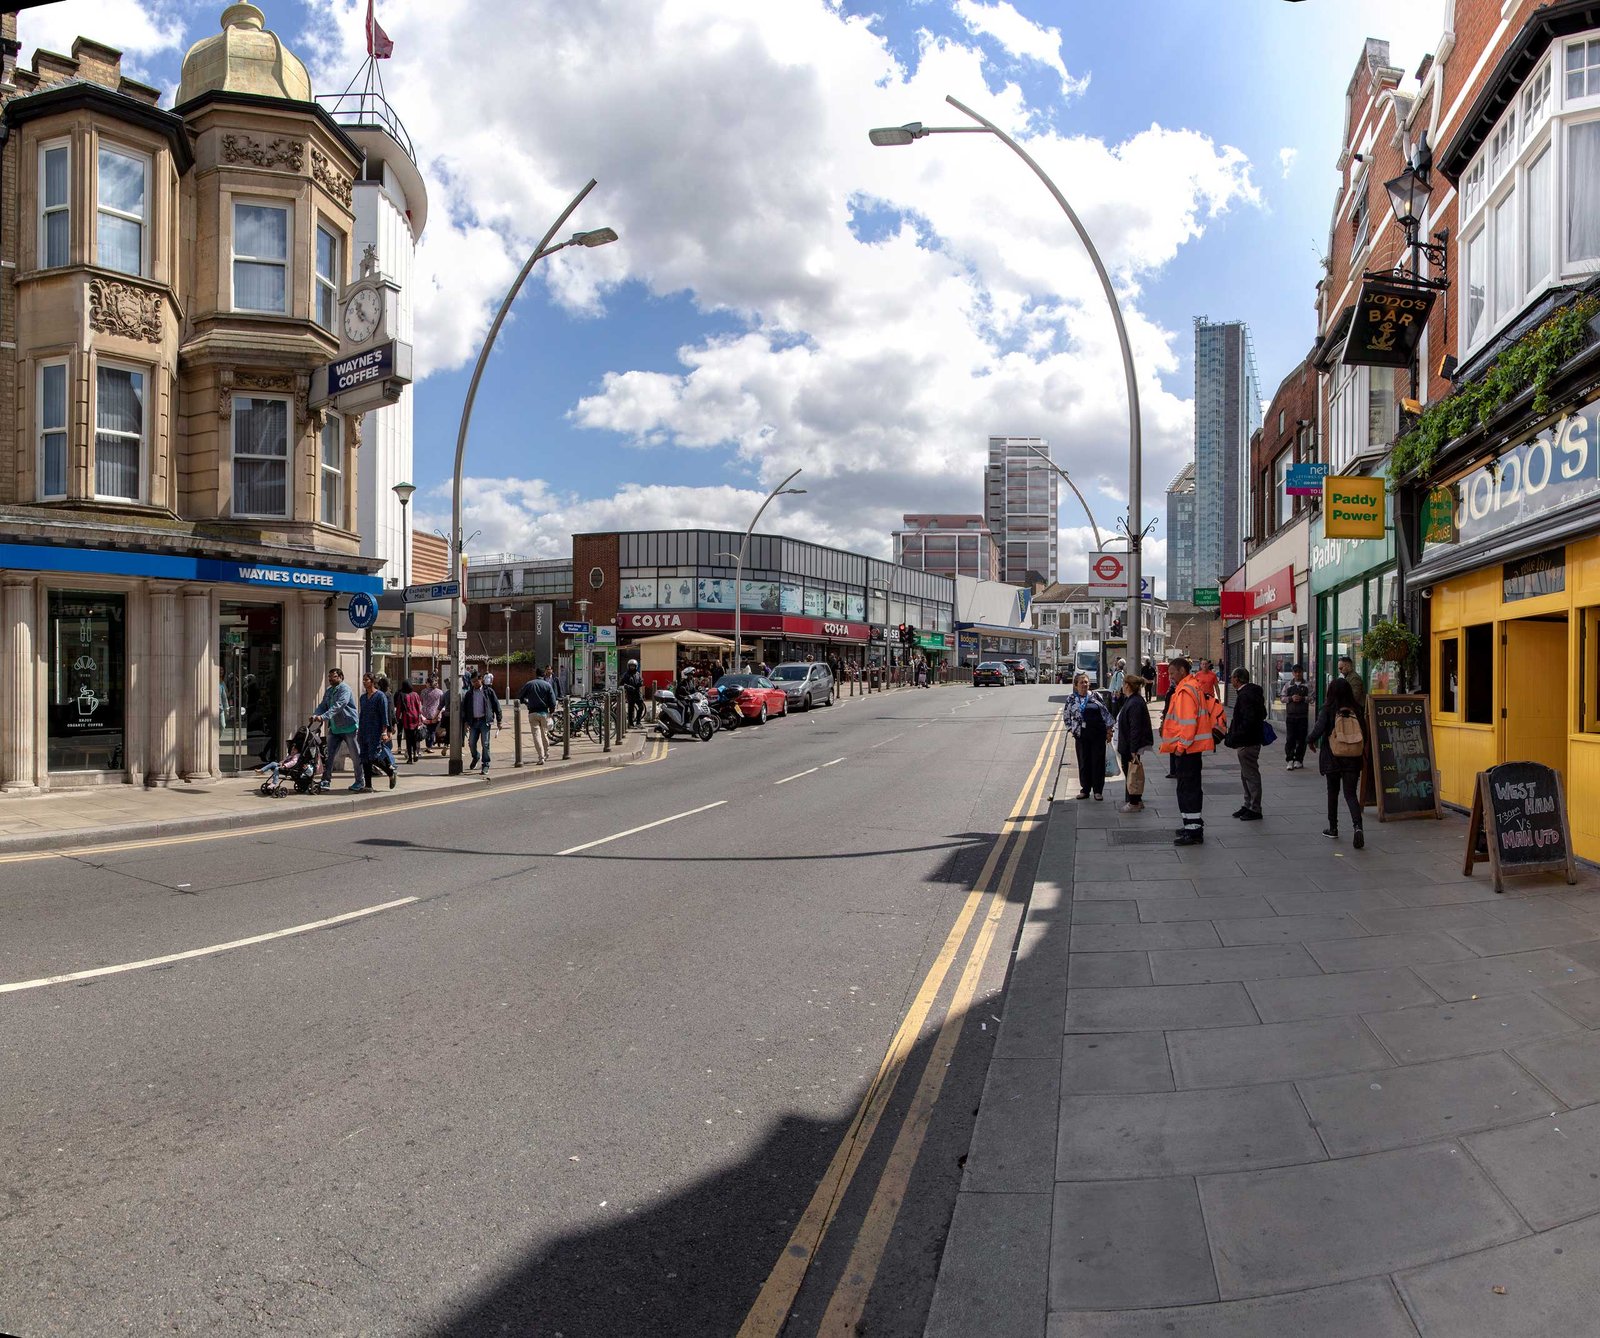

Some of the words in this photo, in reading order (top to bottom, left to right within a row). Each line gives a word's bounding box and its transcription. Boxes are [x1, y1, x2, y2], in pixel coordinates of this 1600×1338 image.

[1369, 309, 1414, 327] BAR
[336, 350, 382, 376] WAYNE'S
[338, 365, 380, 389] COFFEE
[1332, 493, 1377, 507] Paddy
[1332, 510, 1378, 521] Power
[1312, 538, 1342, 572] Paddy
[238, 568, 290, 582] WAYNE'S
[292, 574, 334, 586] COFFEE
[355, 604, 368, 617] W
[631, 614, 682, 628] COSTA
[824, 622, 849, 636] COSTA
[1494, 782, 1536, 800] WEST
[1525, 796, 1554, 815] HAM
[1502, 830, 1534, 849] MAN
[1535, 828, 1560, 848] UTD
